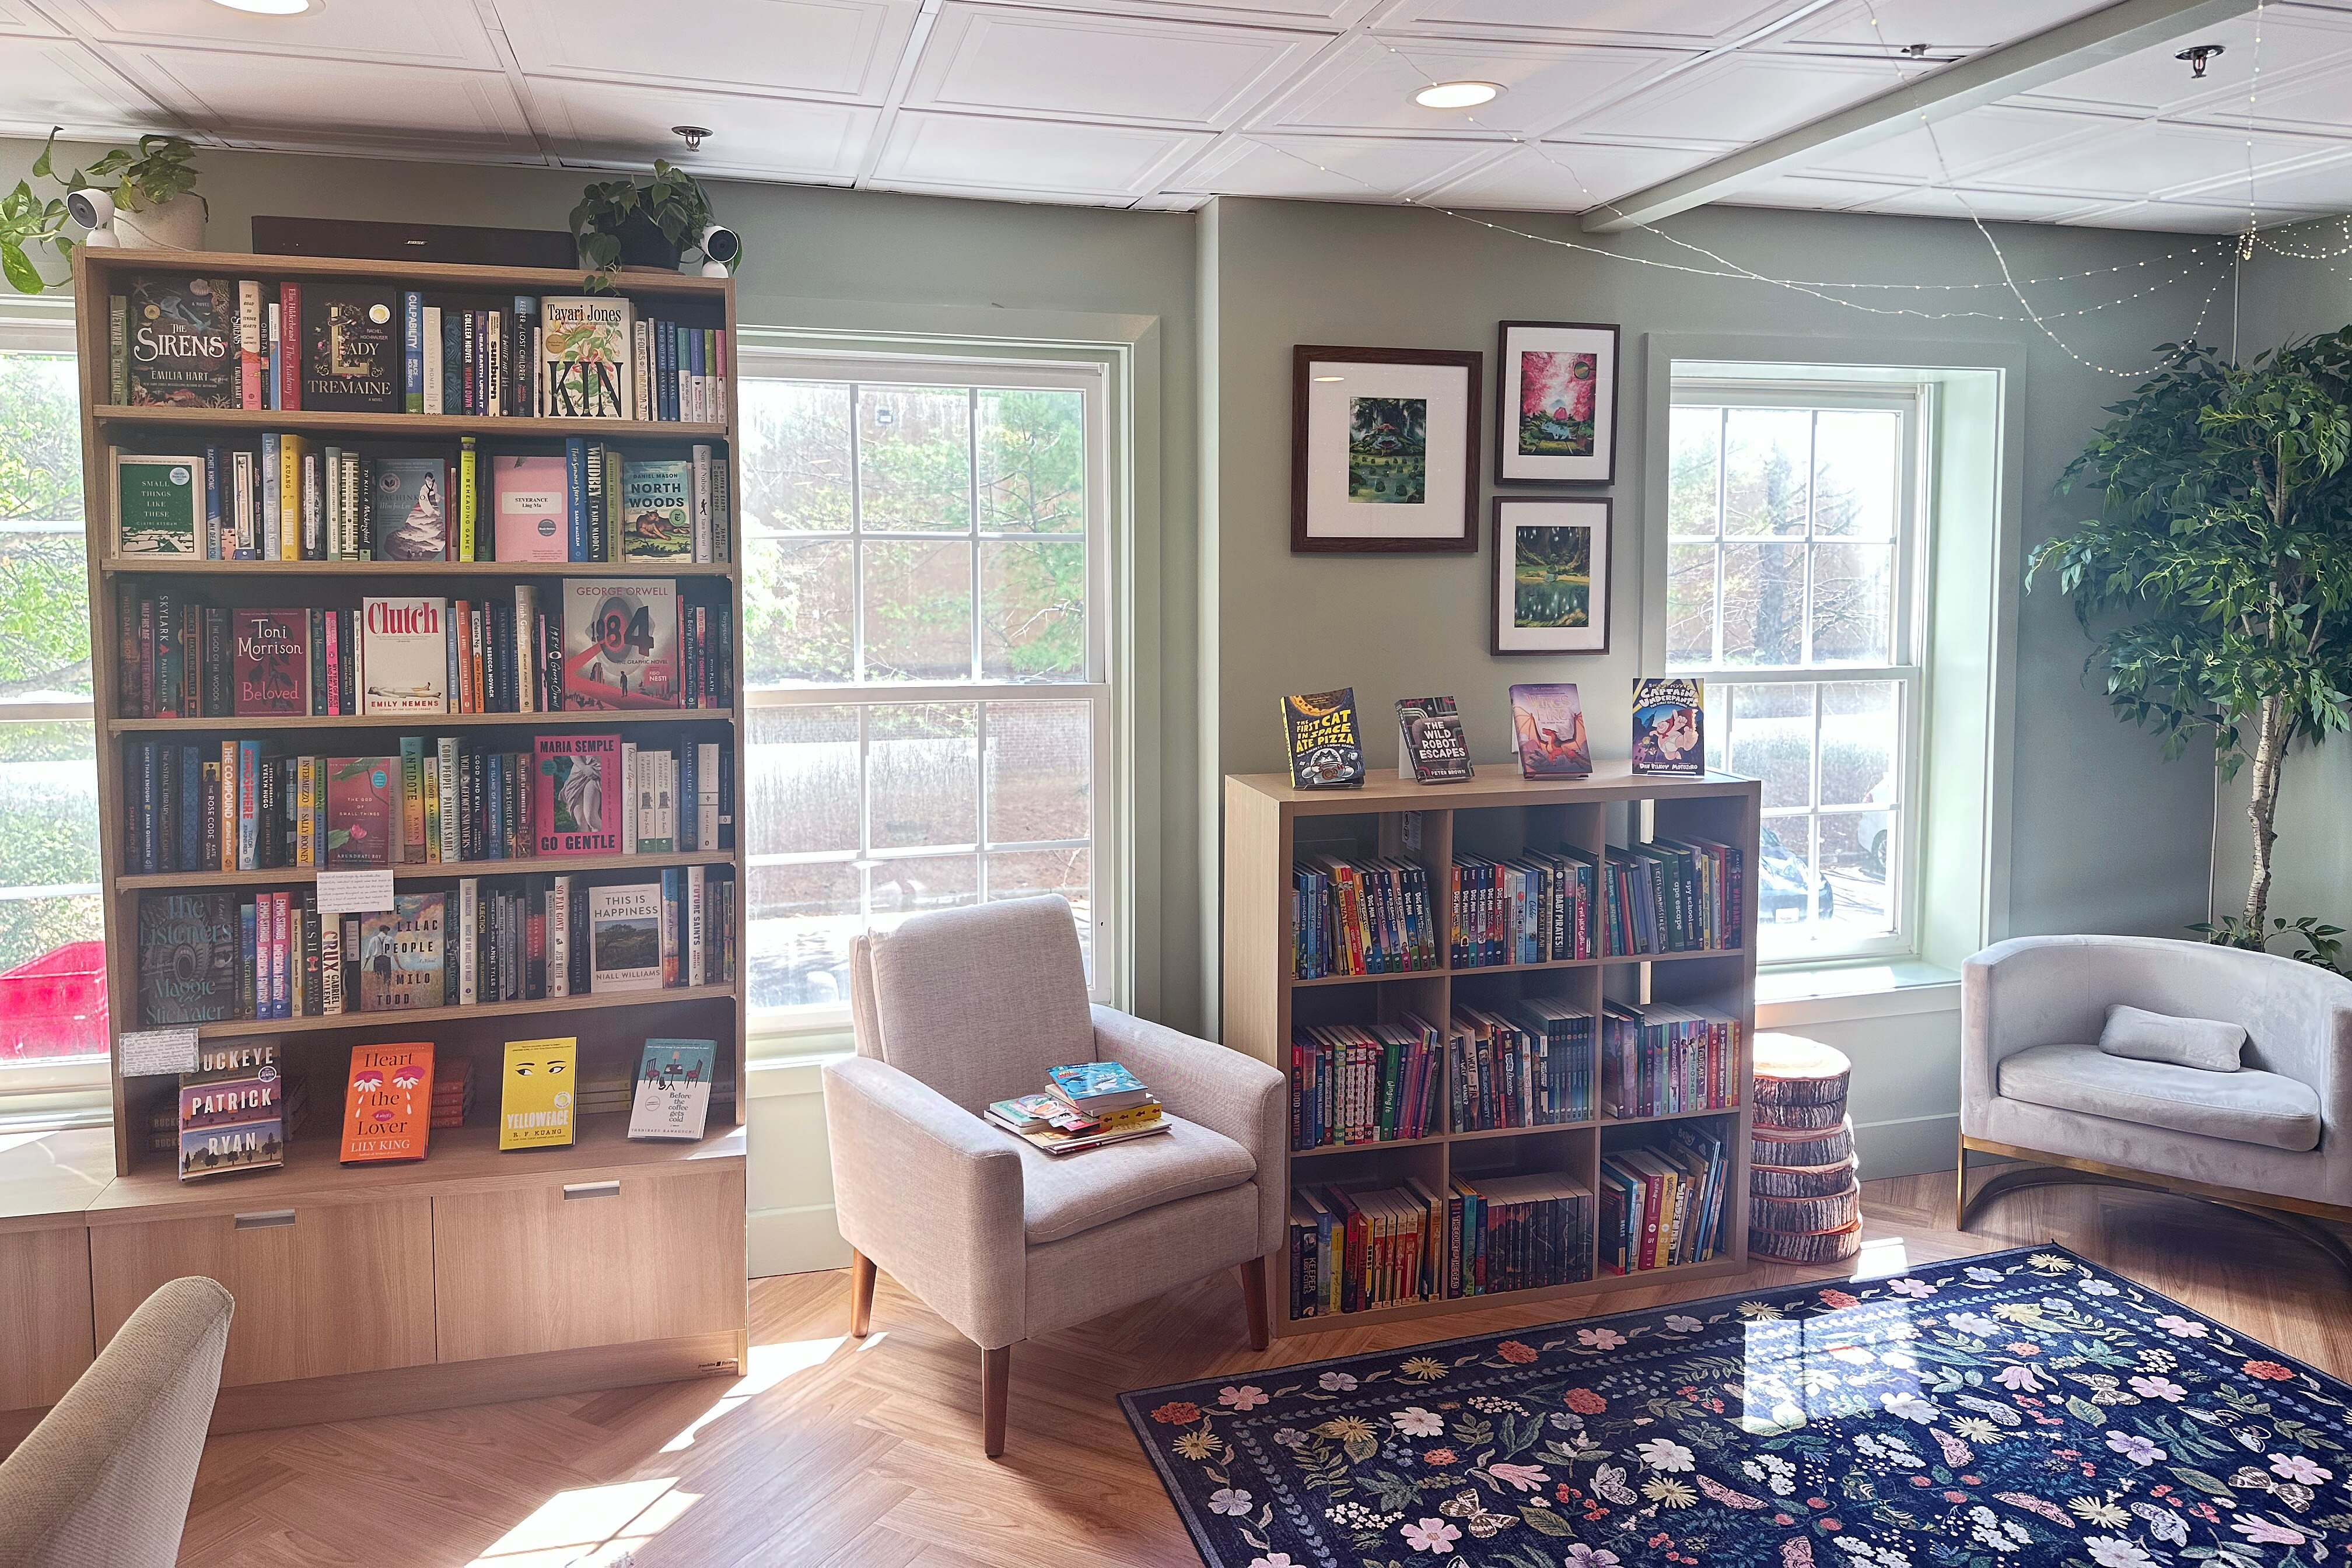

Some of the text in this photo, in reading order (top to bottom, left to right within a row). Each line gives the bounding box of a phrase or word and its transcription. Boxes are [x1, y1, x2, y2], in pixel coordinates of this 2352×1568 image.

[408, 295, 417, 348] CULPABILITY
[547, 304, 622, 325] Tayari Jones
[113, 310, 124, 345] WEYWARD
[172, 324, 187, 334] THE
[134, 327, 226, 362] SIRENS
[112, 359, 124, 395] EMILIA HART
[152, 370, 208, 382] EMILIA HART
[491, 341, 499, 400] sunburn
[307, 380, 392, 396] TREMAINE
[547, 360, 624, 418] KIN
[587, 446, 602, 498] WHIDBEY
[631, 483, 681, 494] NORTH
[629, 497, 684, 508] WOODS
[267, 501, 277, 556] Florence Knapp
[283, 508, 294, 546] YELLOWFACE
[576, 586, 668, 596] GEORGE ORWELL
[159, 595, 169, 641] SKYLARK
[251, 618, 287, 640] Toni
[368, 602, 439, 635] Clutch
[550, 626, 559, 649] 1984
[590, 605, 654, 657] 1984
[238, 637, 303, 661] Morrison
[242, 680, 299, 701] Beloved
[1524, 693, 1572, 710] WINGS
[1639, 695, 1699, 707] UNDERPANTS
[1640, 687, 1694, 698] CAPTAIN
[1296, 709, 1352, 733] FIRST CAT
[1297, 723, 1352, 740] IN SPACE
[1424, 721, 1444, 729] THE
[540, 740, 614, 753] MARIA SEMPLE
[1296, 733, 1354, 753] ATE PIZZA
[1421, 738, 1457, 750] ROBOT
[1424, 729, 1451, 740] WILD
[1419, 747, 1466, 759] ESCAPES
[406, 750, 418, 800] ANTIDOTE
[442, 744, 452, 790] GOOD PEOPLE
[224, 746, 233, 818] THE COMPOUND
[243, 748, 254, 820] ATMOSPHERE
[302, 760, 310, 803] INTERMEZZO
[443, 797, 453, 852] PATMEENA SABIT
[461, 786, 470, 848] GEORGE SAUNDERS
[300, 835, 309, 863] ROONEY
[541, 834, 615, 850] GO GENTLE
[167, 895, 205, 920] The
[594, 905, 659, 918] HAPPINESS
[606, 895, 646, 905] THIS IS
[1528, 900, 1536, 919] Odder
[259, 902, 269, 943] EMMA STRAUB
[275, 899, 286, 940] EMMA STRAUB
[306, 897, 317, 952] FLESH
[397, 920, 438, 932] LILAC
[1555, 894, 1564, 946] BABY PIRATES
[1674, 900, 1682, 930] escape
[140, 923, 232, 946] Listeners
[323, 931, 339, 972] CRUX
[384, 942, 433, 954] PEOPLE
[244, 955, 255, 1000] Sacrament
[396, 974, 430, 985] MILO
[621, 970, 660, 978] WILLIAMS
[155, 978, 216, 1007] Maggie
[331, 975, 340, 1005] GABRIEL
[376, 993, 410, 1006] TODD
[203, 1046, 274, 1072] UCKEYE
[365, 1052, 413, 1068] Heart
[1467, 1055, 1476, 1073] WOLF
[191, 1088, 272, 1115] PATRICK
[371, 1091, 400, 1106] the
[357, 1121, 408, 1135] Lover
[507, 1110, 569, 1130] YELLOWFACE
[208, 1132, 256, 1156] RYAN
[351, 1139, 410, 1153] LILY KING
[1670, 1182, 1686, 1250] SUSPENDED
[1308, 1257, 1317, 1293] KEEPER
